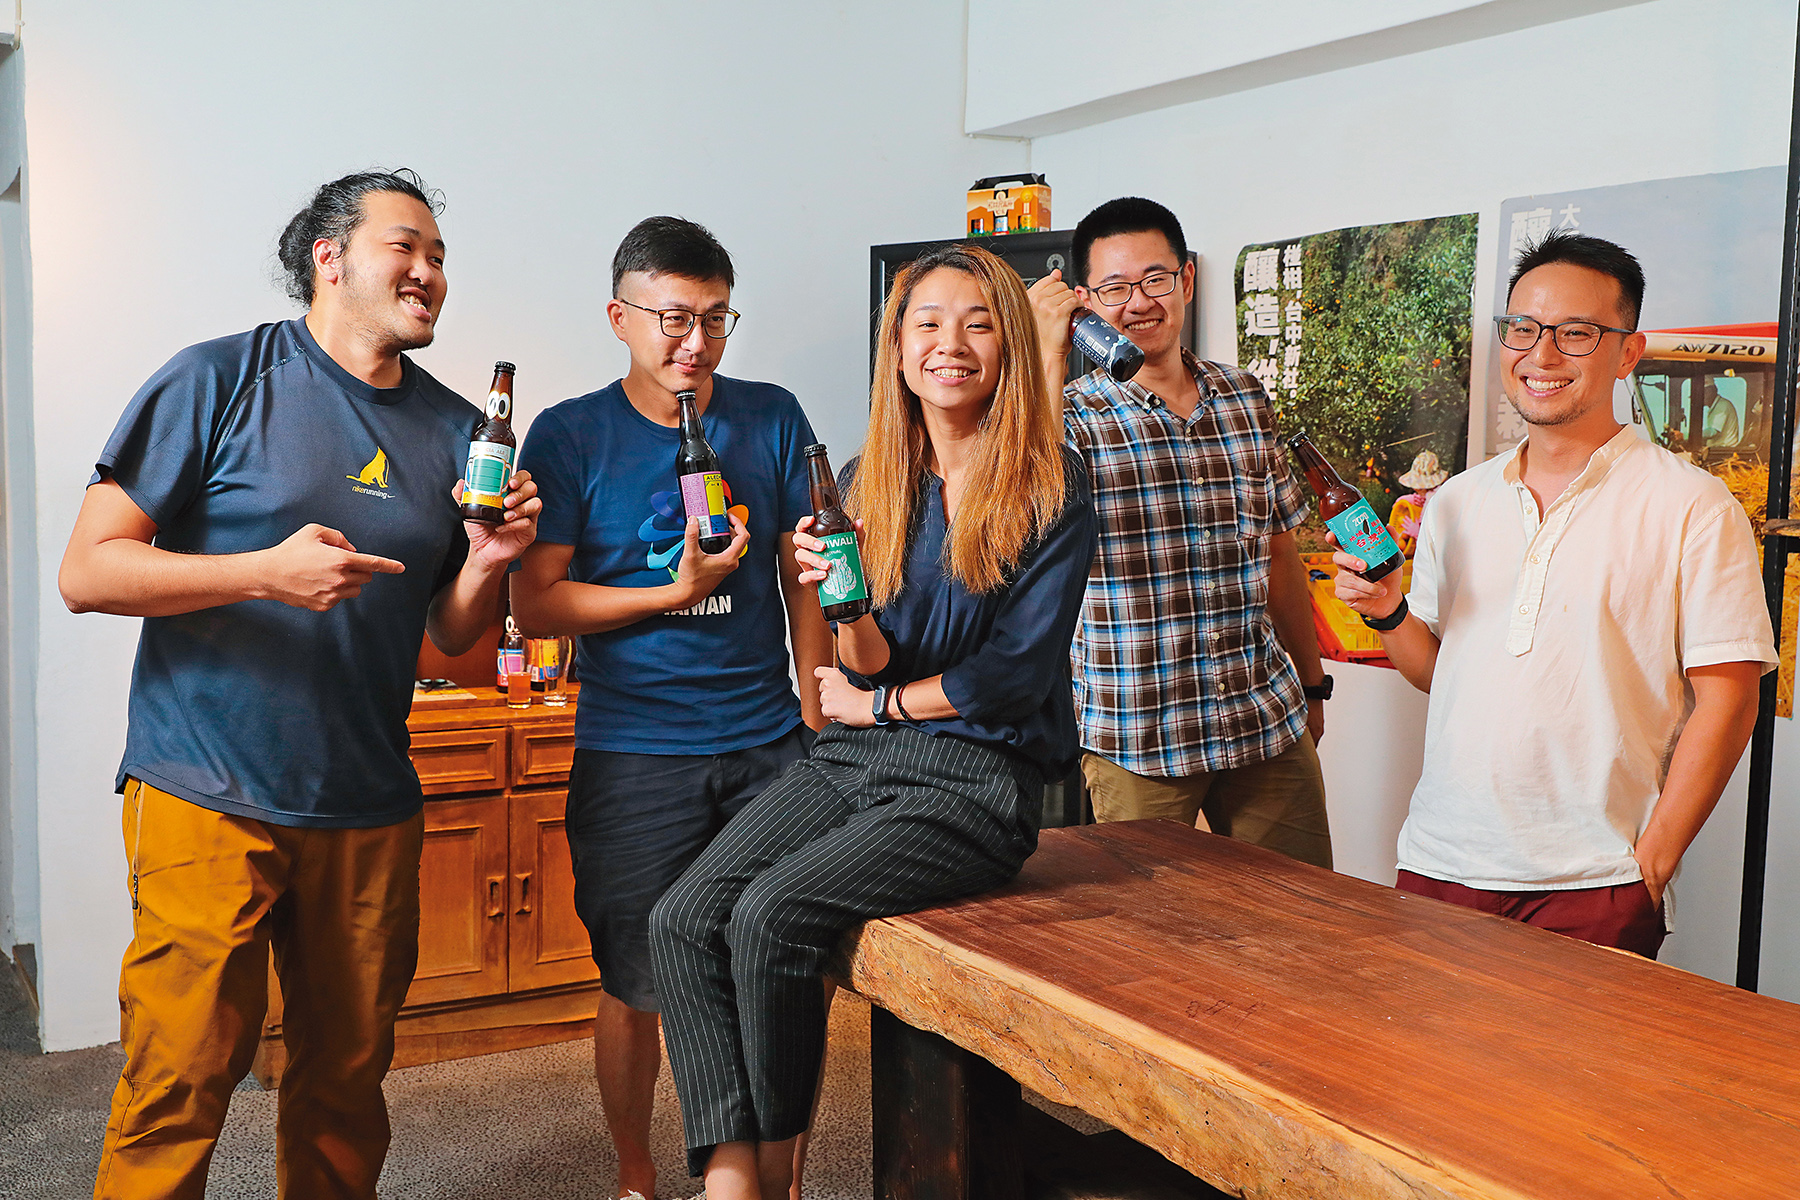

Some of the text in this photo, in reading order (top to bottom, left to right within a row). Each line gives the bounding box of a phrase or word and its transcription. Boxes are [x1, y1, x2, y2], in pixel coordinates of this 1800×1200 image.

[1671, 342, 1766, 357] AW7120
[351, 485, 388, 499] nikerunning
[825, 536, 854, 549] IWALI
